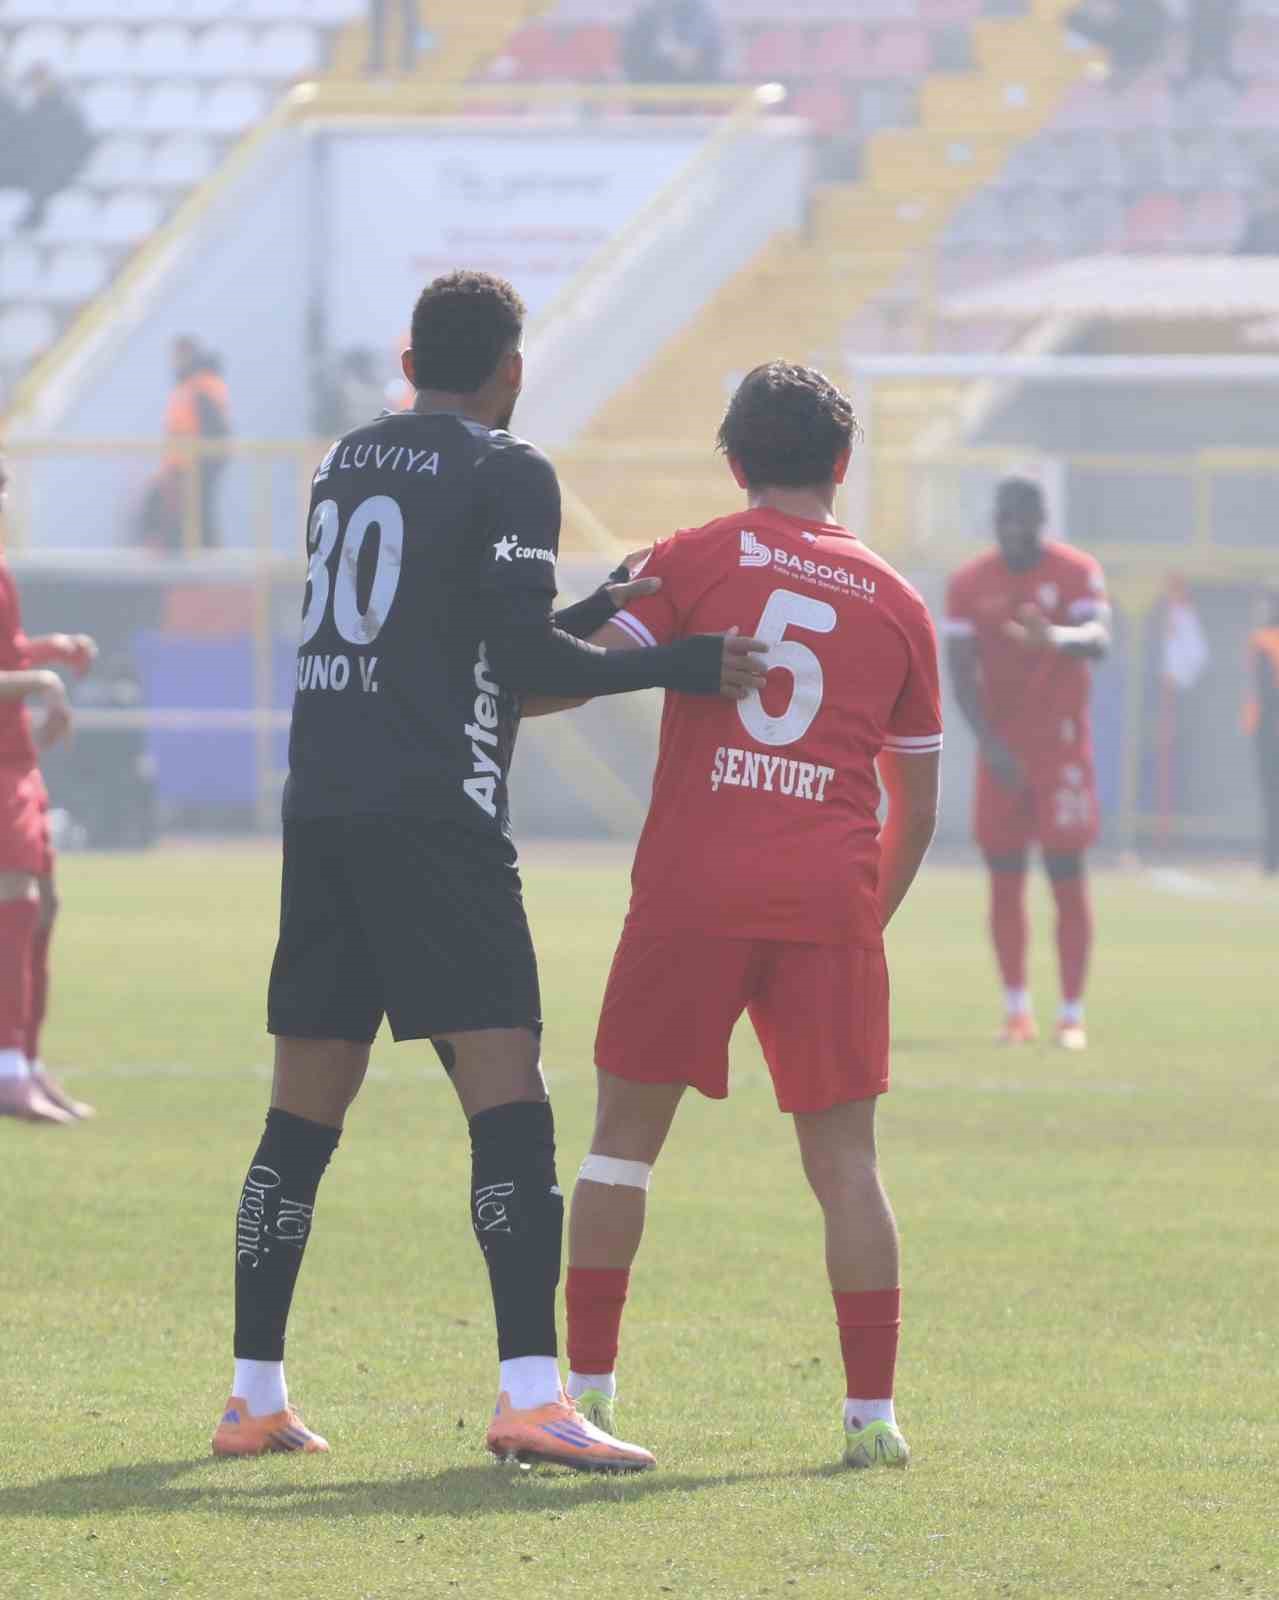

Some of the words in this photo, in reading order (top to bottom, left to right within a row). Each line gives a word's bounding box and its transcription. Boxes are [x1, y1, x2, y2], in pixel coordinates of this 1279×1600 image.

[339, 443, 440, 475] LUVIYA
[301, 495, 404, 645] 30
[774, 548, 876, 594] BAŞOĞLU
[297, 655, 350, 691] UNO
[359, 656, 378, 692] V.
[737, 588, 837, 746] 5
[711, 746, 835, 802] ŞENYURT
[238, 1165, 280, 1268] Organic
